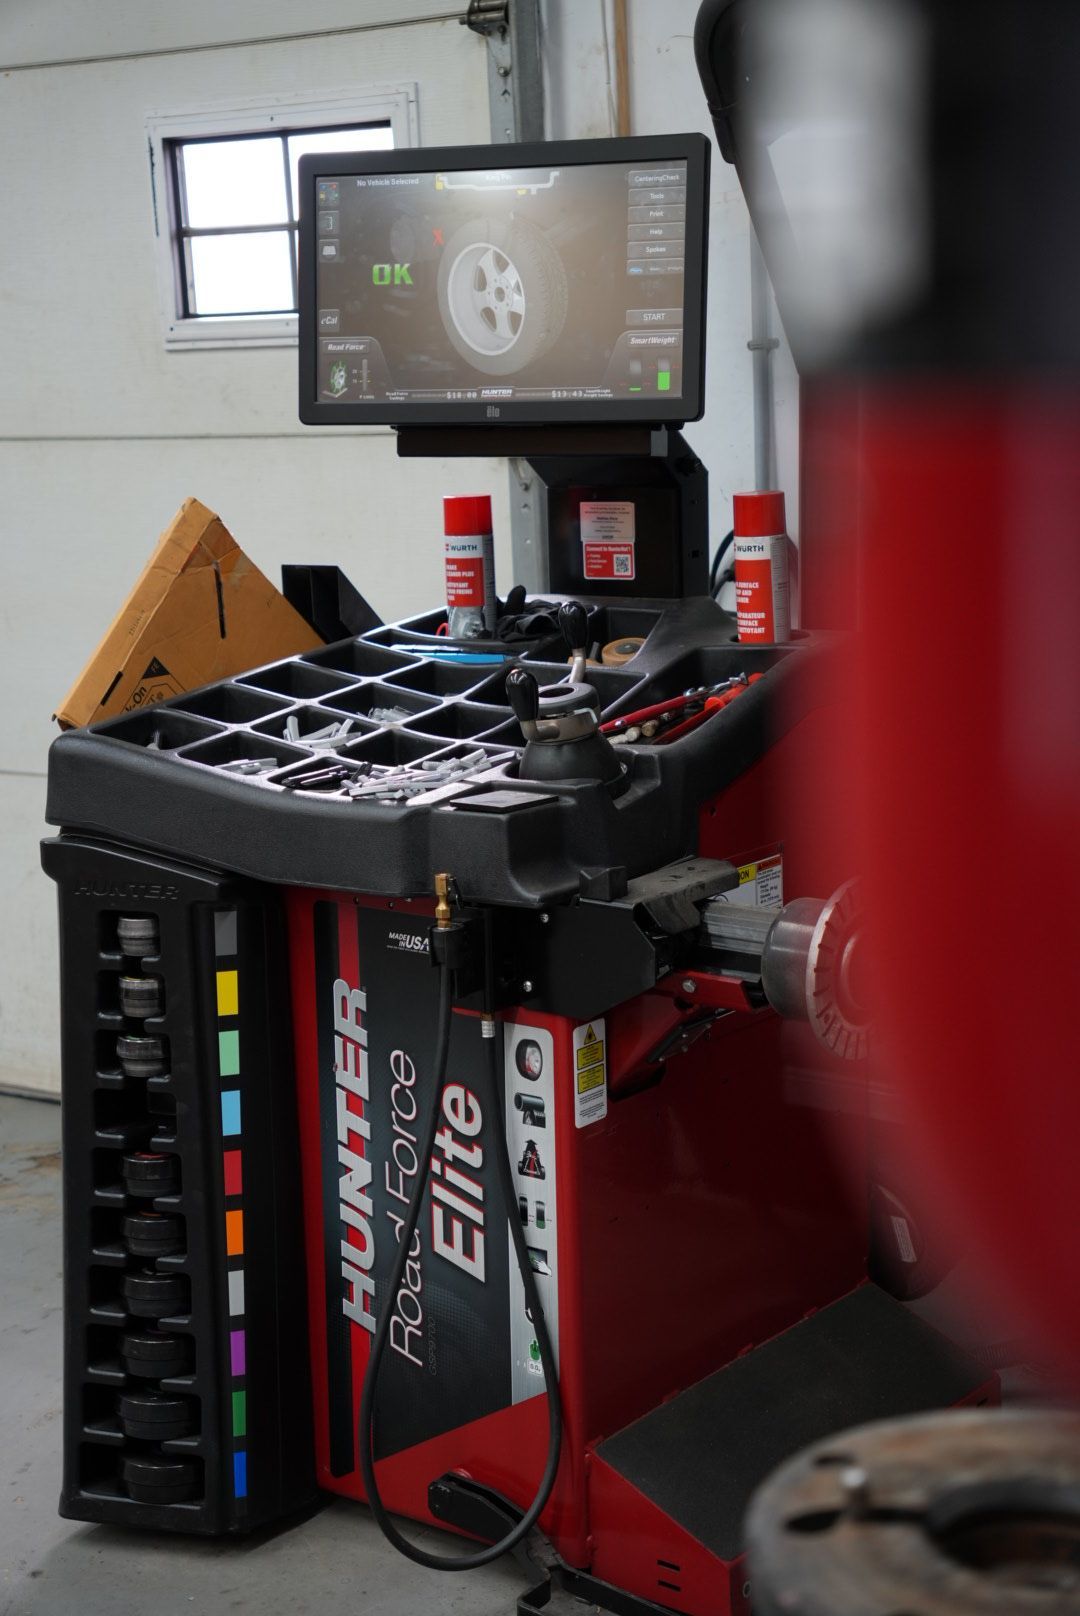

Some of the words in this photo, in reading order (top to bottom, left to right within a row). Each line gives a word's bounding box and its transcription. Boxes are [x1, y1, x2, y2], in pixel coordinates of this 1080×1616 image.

[372, 263, 413, 285] OK
[630, 336, 675, 345] SmartWeight
[481, 388, 513, 396] HUNTER
[388, 931, 407, 941] MADE
[398, 940, 406, 948] IN
[405, 934, 430, 952] USA
[385, 1049, 418, 1204] Force
[333, 978, 377, 1335] HUNTER
[431, 1082, 486, 1284] Elite
[386, 1210, 423, 1367] Road
